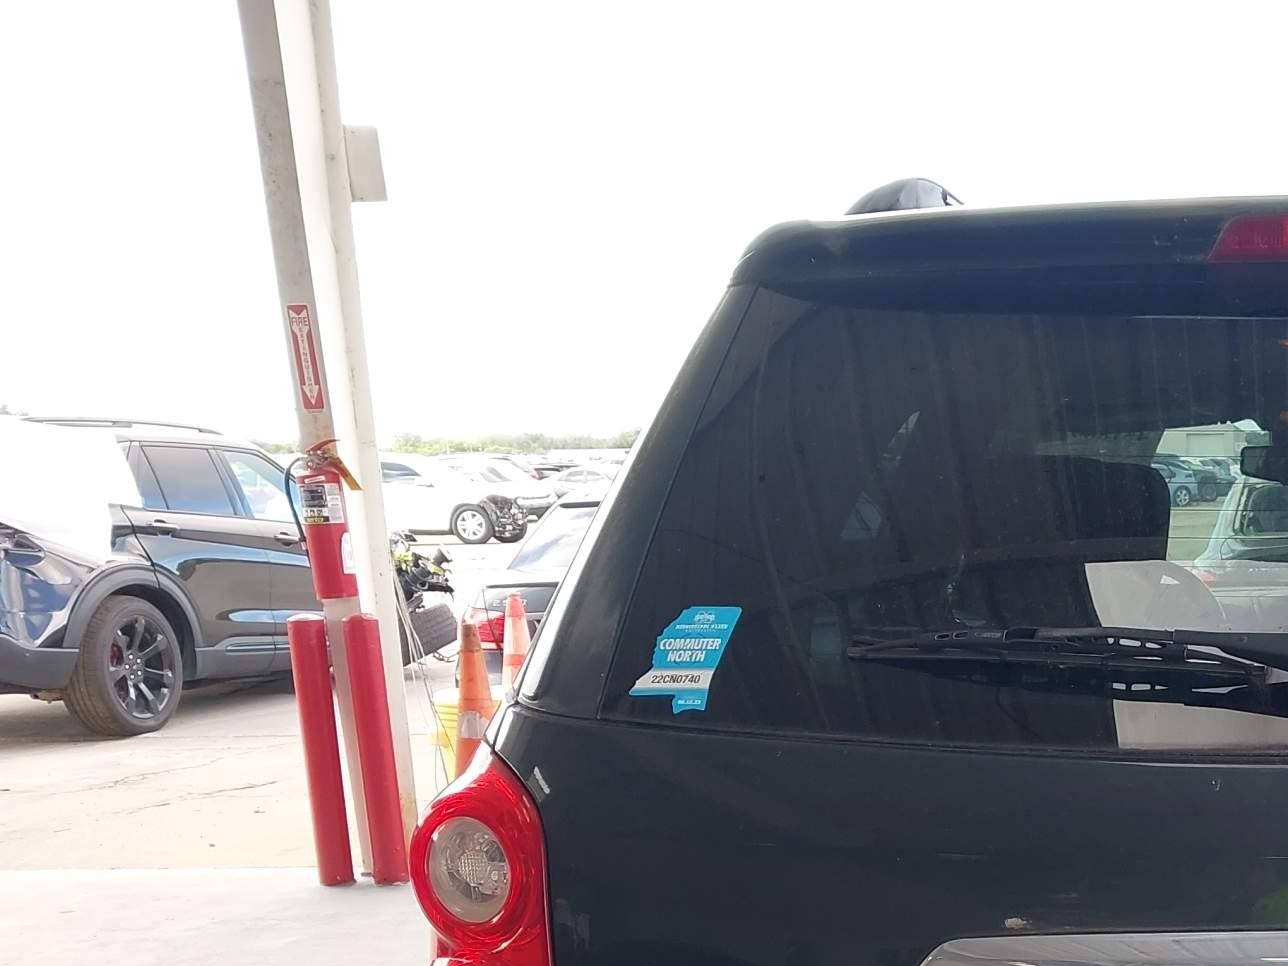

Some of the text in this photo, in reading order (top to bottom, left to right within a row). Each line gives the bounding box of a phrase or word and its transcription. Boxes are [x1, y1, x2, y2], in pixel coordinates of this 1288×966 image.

[290, 317, 309, 326] FIRE
[659, 638, 722, 650] COMMUTER
[667, 650, 705, 662] NORTH
[651, 674, 701, 684] 22CN0740
